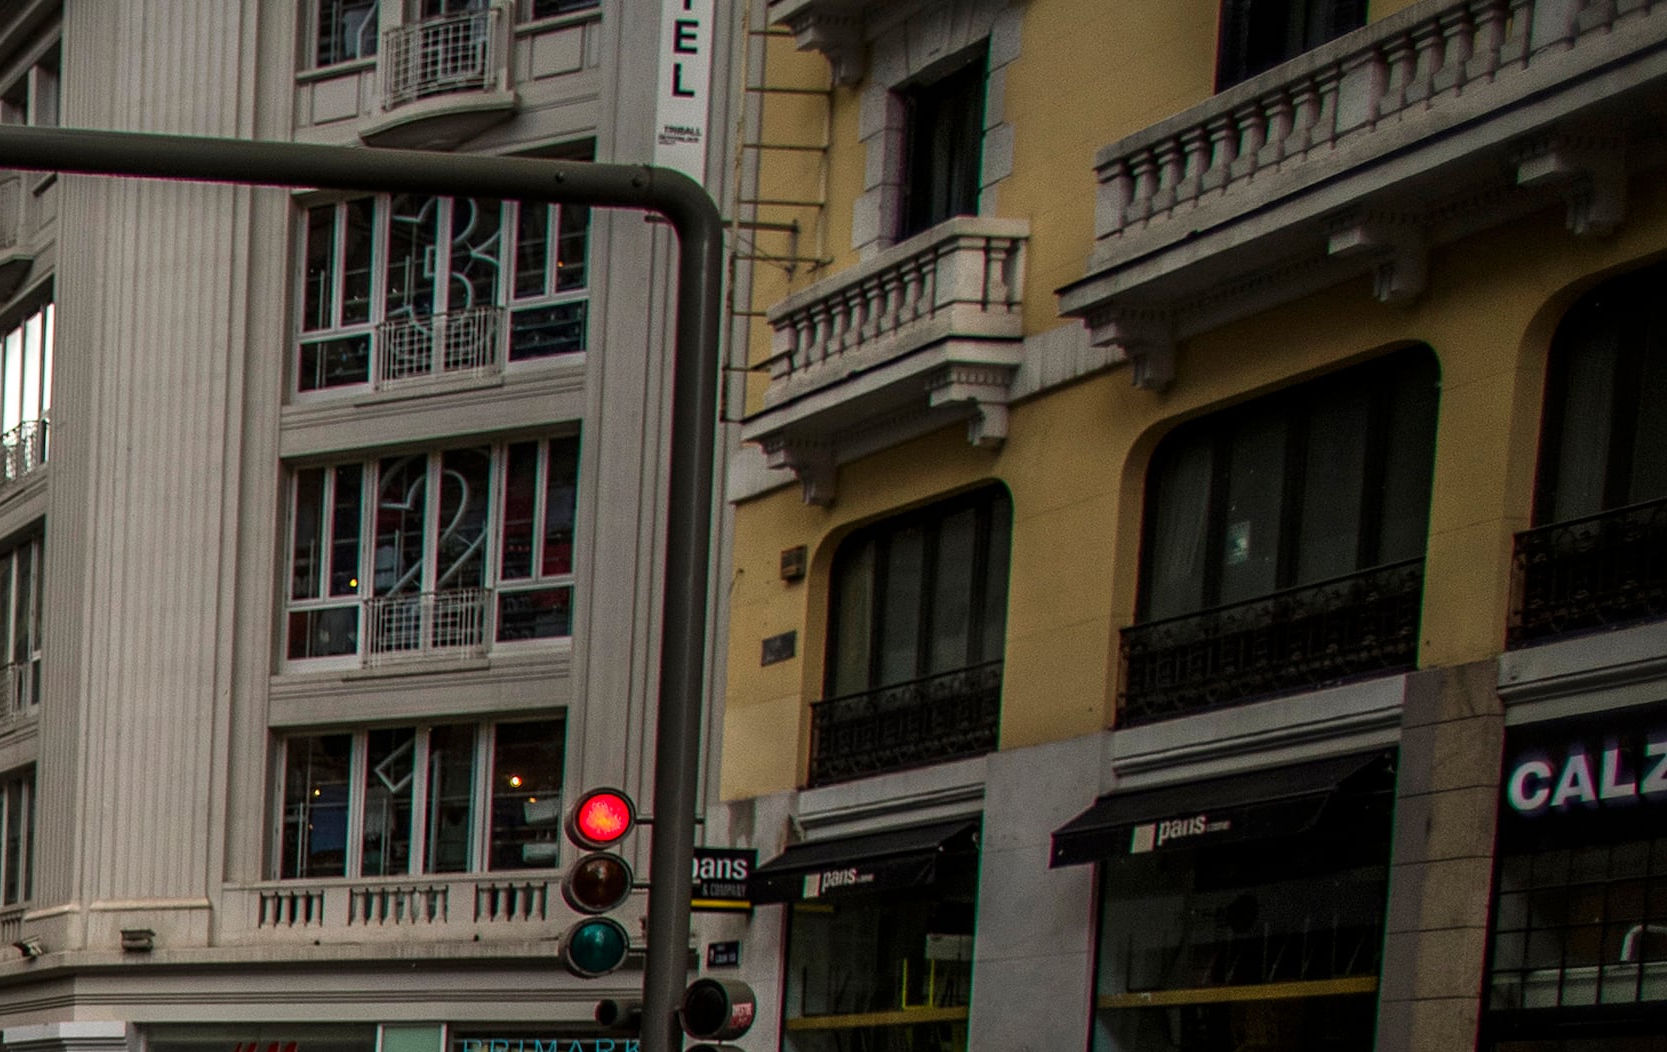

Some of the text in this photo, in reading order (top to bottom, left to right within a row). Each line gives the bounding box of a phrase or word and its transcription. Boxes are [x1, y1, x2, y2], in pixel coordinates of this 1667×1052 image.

[1507, 741, 1667, 811] CALZ
[1156, 813, 1208, 847] pans
[821, 866, 858, 893] pans
